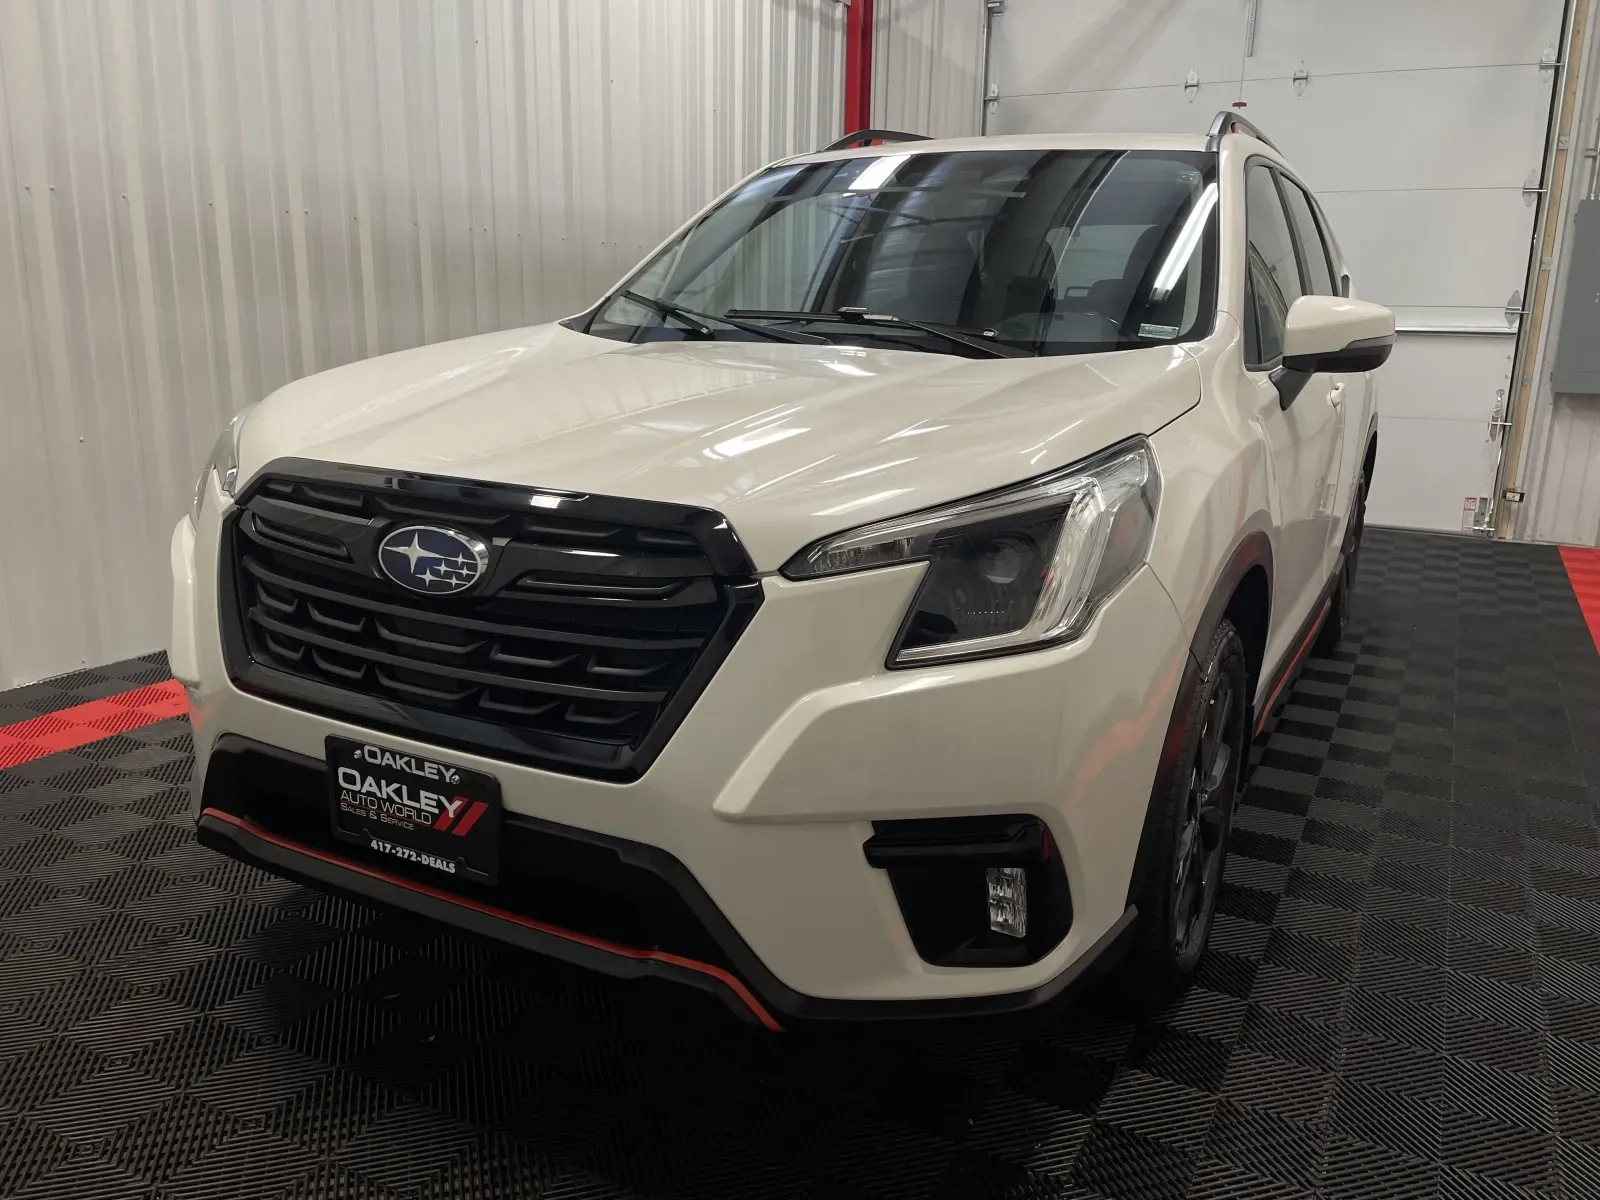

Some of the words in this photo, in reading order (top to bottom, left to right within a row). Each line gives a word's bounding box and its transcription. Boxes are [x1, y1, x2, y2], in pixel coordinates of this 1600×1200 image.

[364, 745, 456, 783] OAKLEY
[338, 767, 462, 818] OAKLEY
[341, 790, 378, 809] AUTO
[380, 800, 432, 825] WORLD
[369, 810, 378, 820] &
[370, 839, 456, 874] 417-272-DEALS
